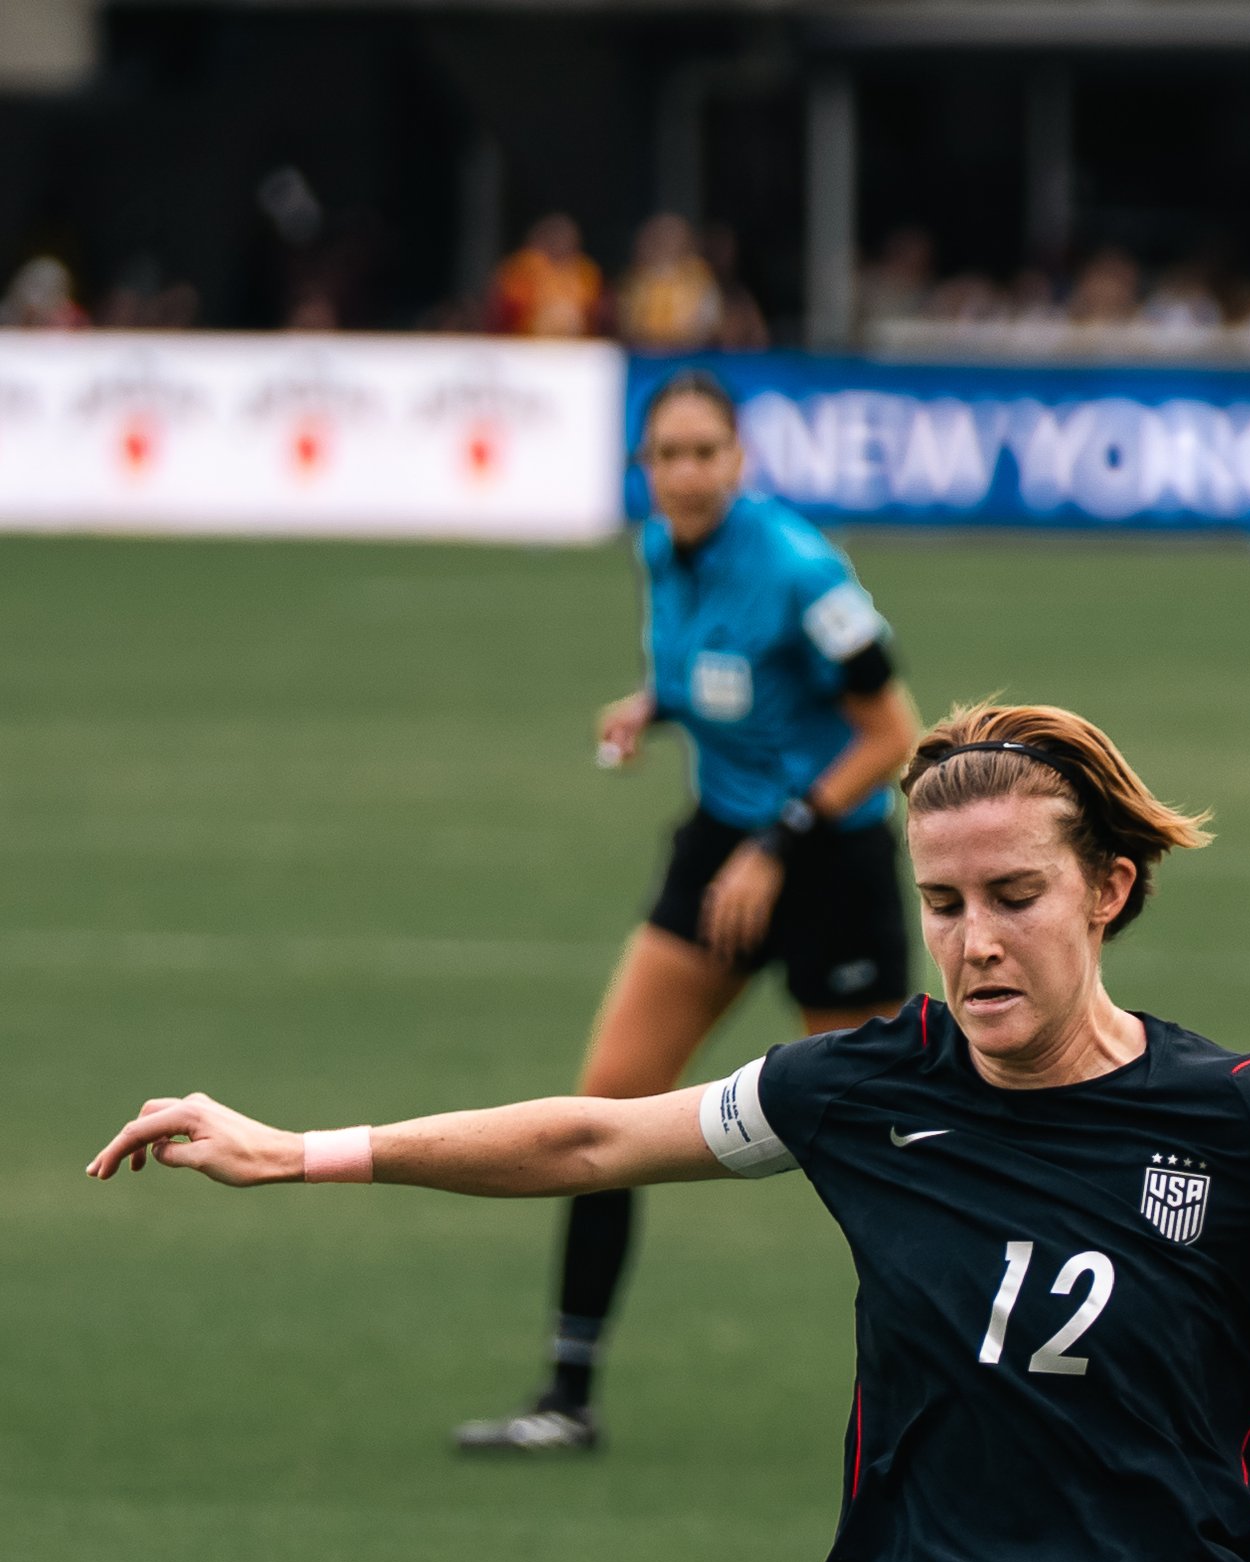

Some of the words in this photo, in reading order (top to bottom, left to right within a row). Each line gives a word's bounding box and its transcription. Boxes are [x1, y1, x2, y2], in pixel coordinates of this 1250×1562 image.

[745, 393, 1000, 509] NEW
[1149, 1173, 1205, 1208] USA
[978, 1240, 1116, 1376] 12
